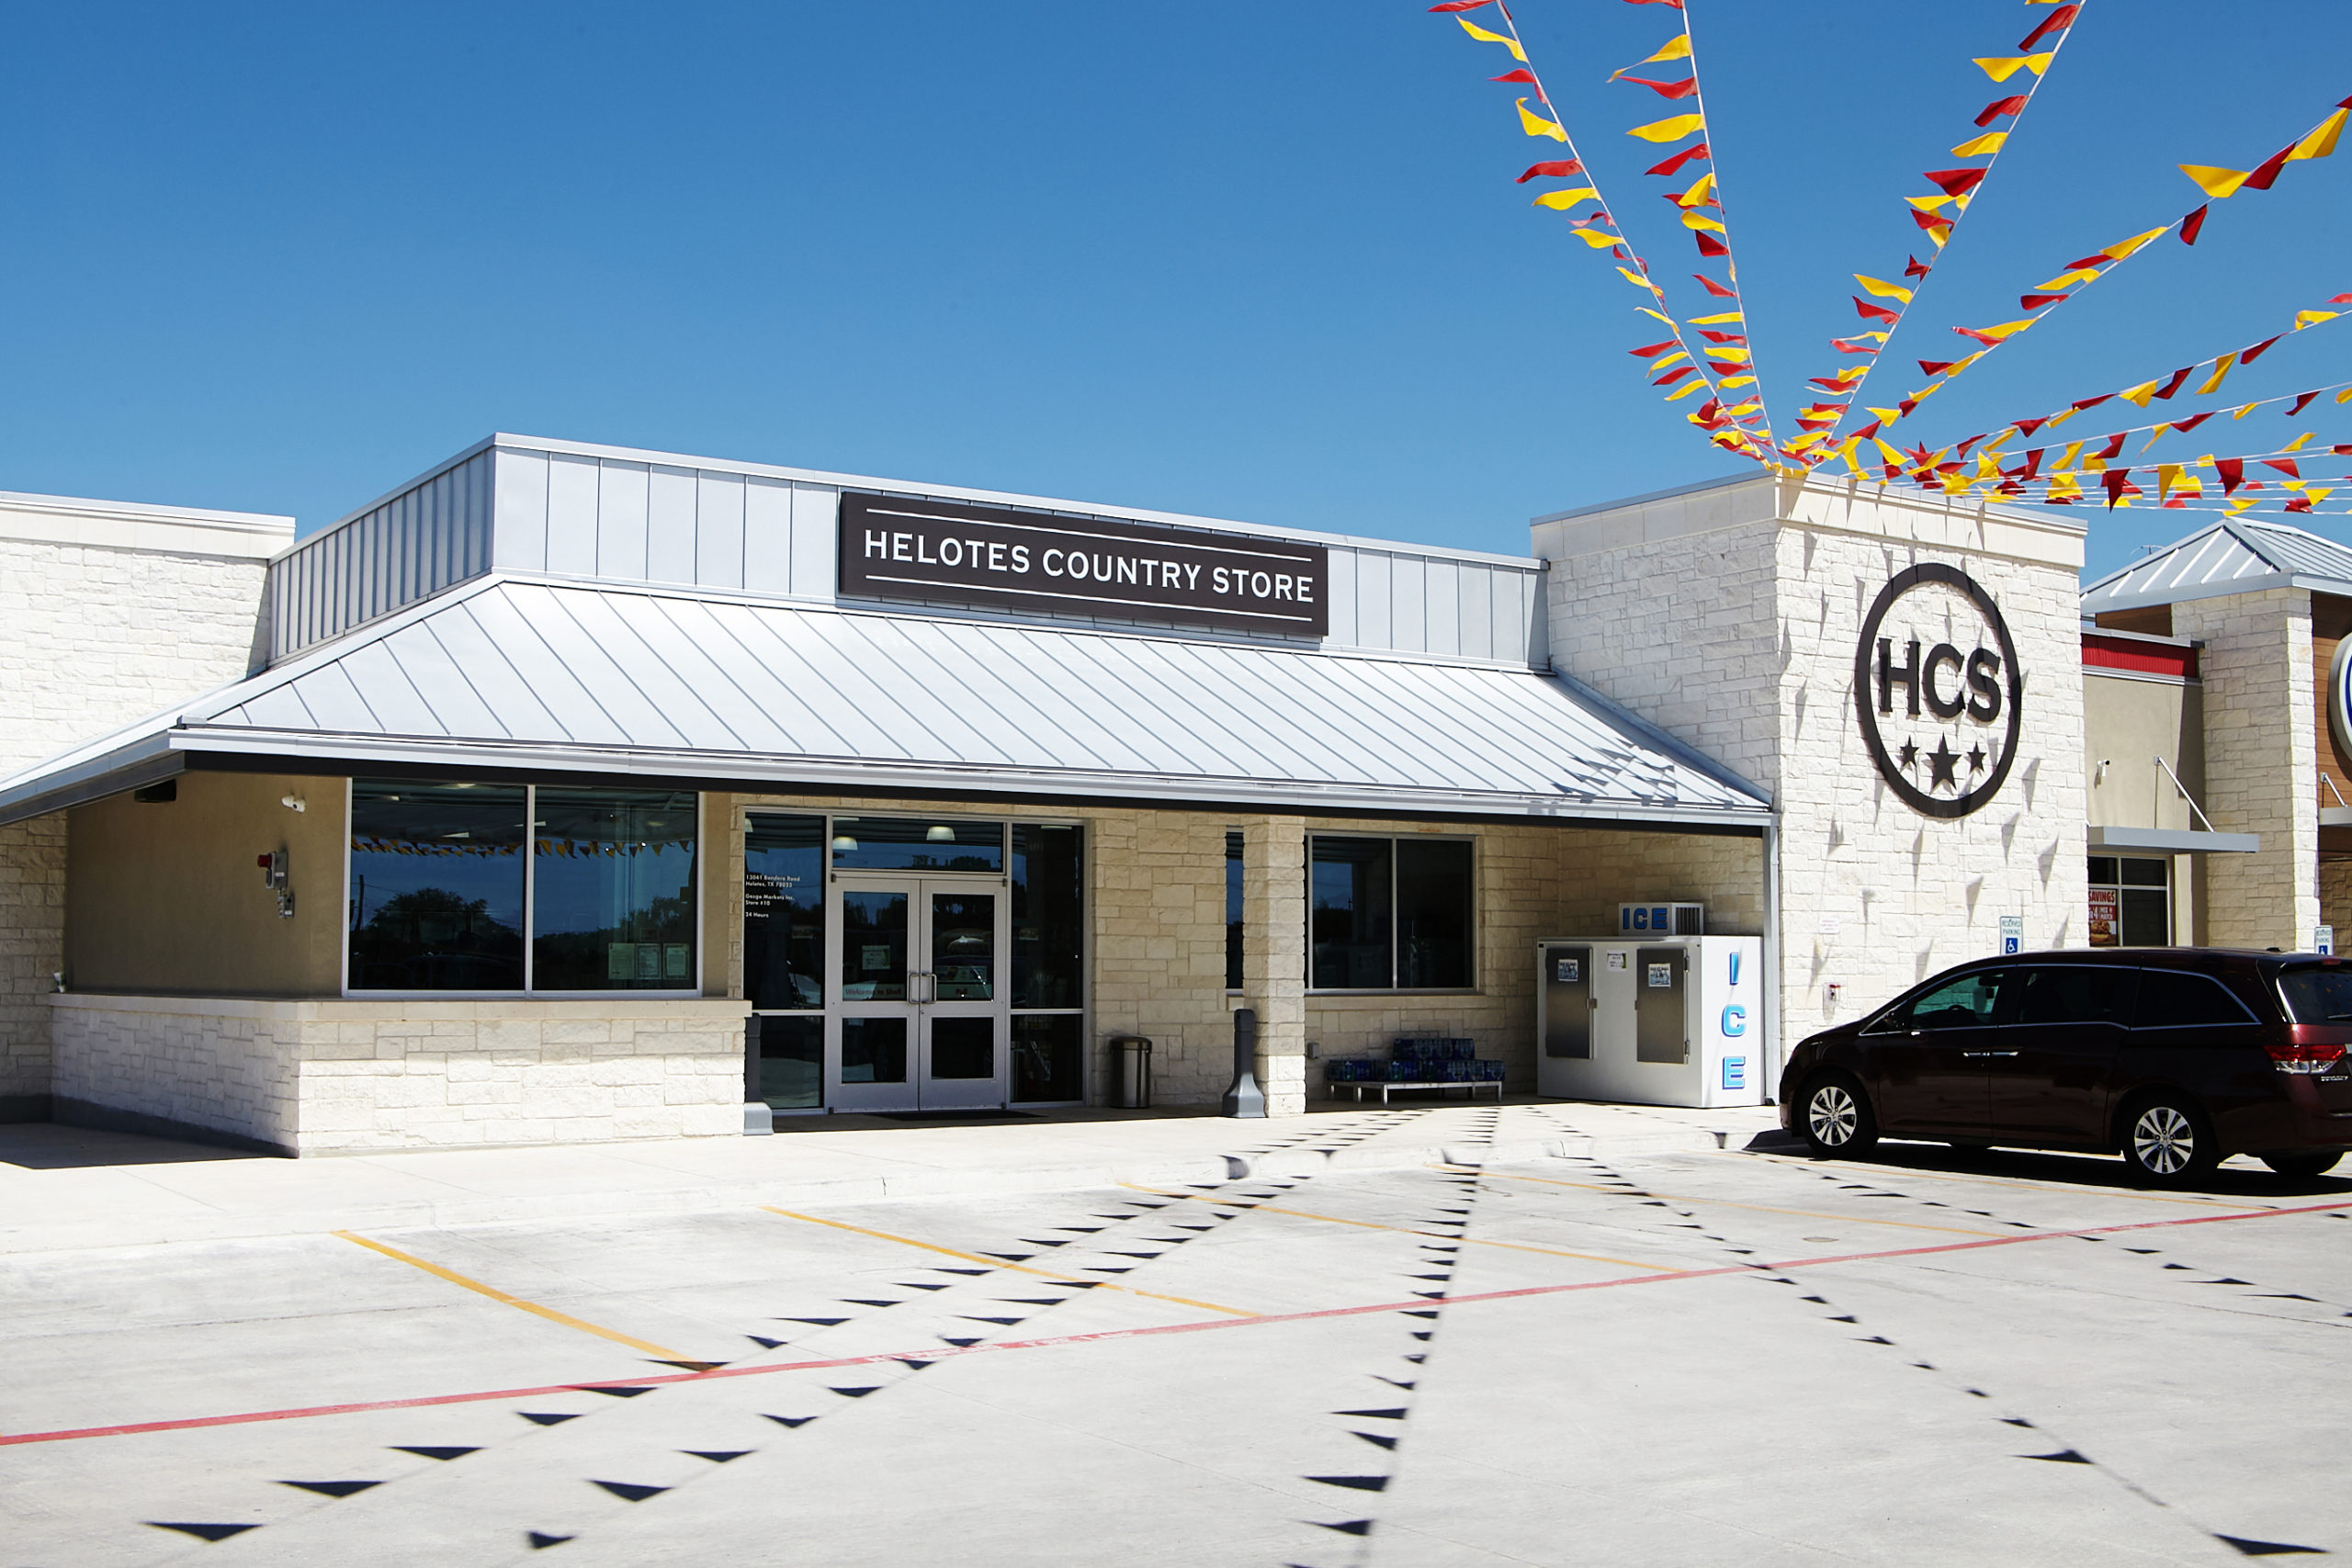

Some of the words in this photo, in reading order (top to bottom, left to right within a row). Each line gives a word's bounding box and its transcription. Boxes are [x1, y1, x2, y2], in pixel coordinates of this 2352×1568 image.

[865, 529, 1031, 574] HELOTES
[1042, 549, 1202, 591] COUNTRY
[1212, 566, 1315, 604] STORE
[1878, 637, 2002, 724] HCS
[1623, 907, 1668, 930] ICE
[2088, 889, 2115, 903] SAVINGS
[1721, 951, 1747, 1090] ICE
